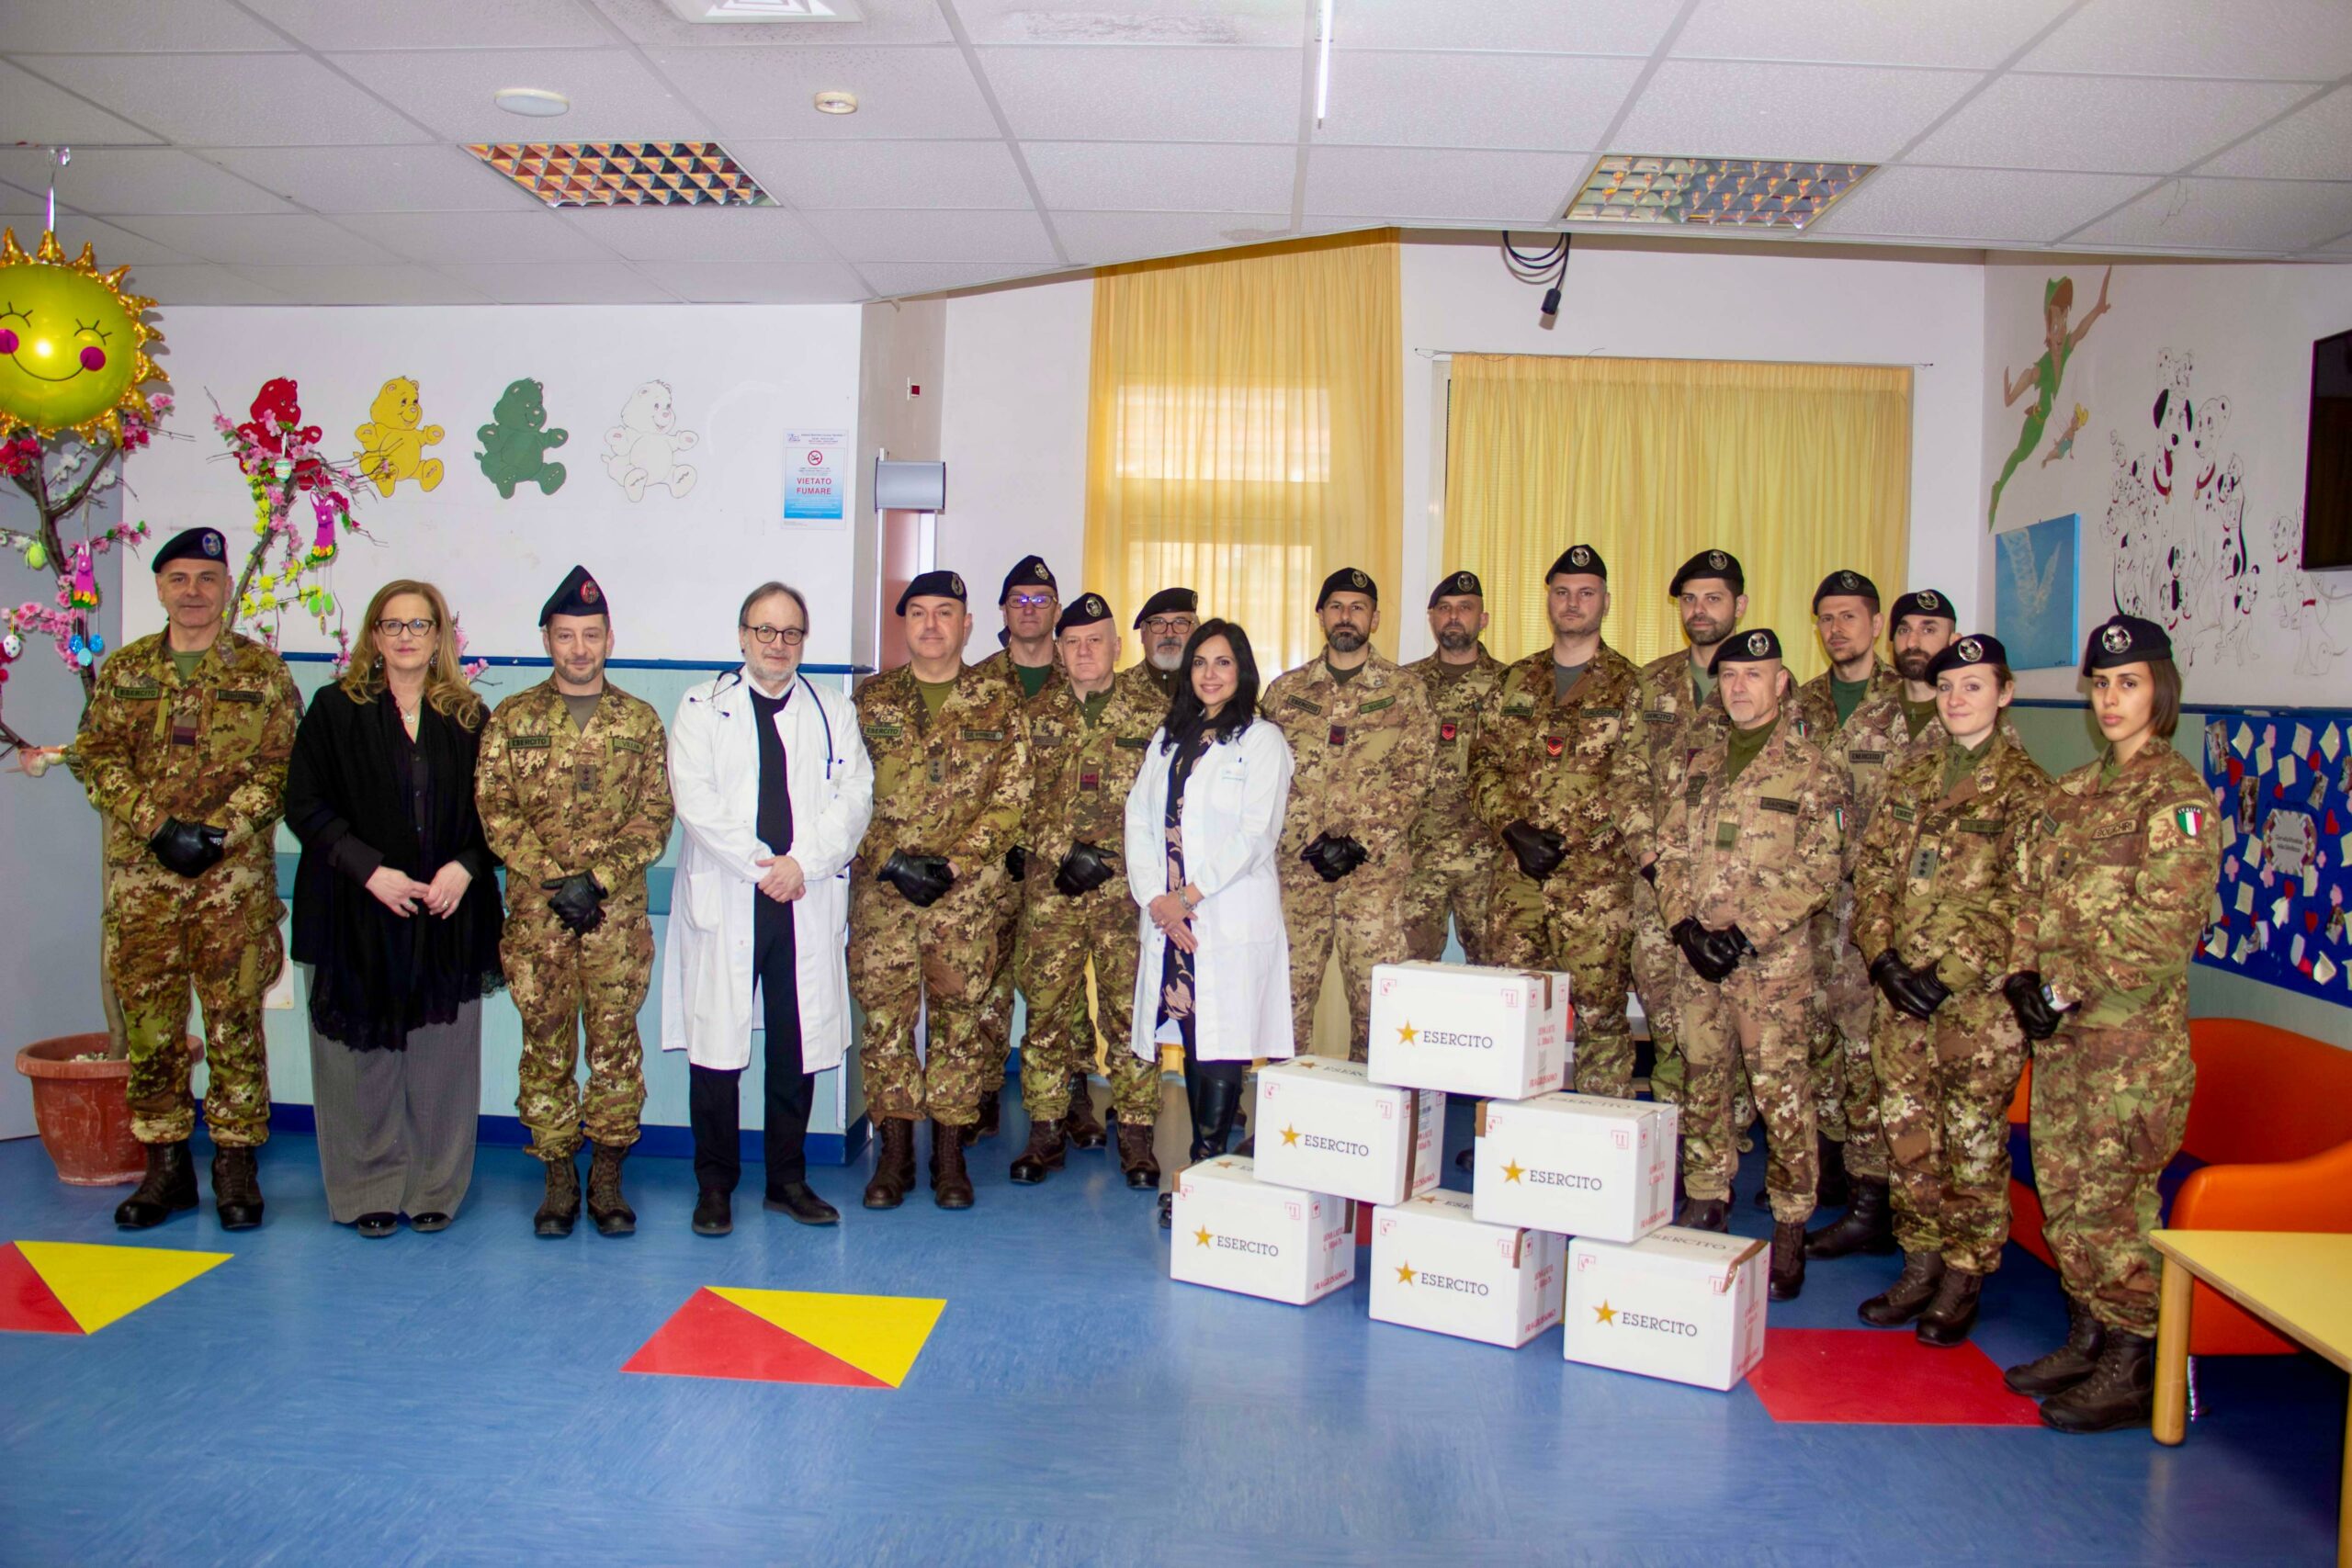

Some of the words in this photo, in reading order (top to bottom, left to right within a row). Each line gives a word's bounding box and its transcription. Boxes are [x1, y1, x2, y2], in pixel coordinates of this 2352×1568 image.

[797, 487, 831, 495] FUMARE
[512, 738, 547, 747] ESERCITO
[866, 727, 899, 736] ESERCITO
[1422, 1030, 1493, 1049] ESERCITO
[1304, 1134, 1369, 1157] ESERCITO
[1529, 1168, 1602, 1191] ESERCITO
[1216, 1235, 1279, 1258] ESERCITO
[1420, 1271, 1489, 1297] ESERCITO
[1622, 1311, 1698, 1337] ESERCITO
